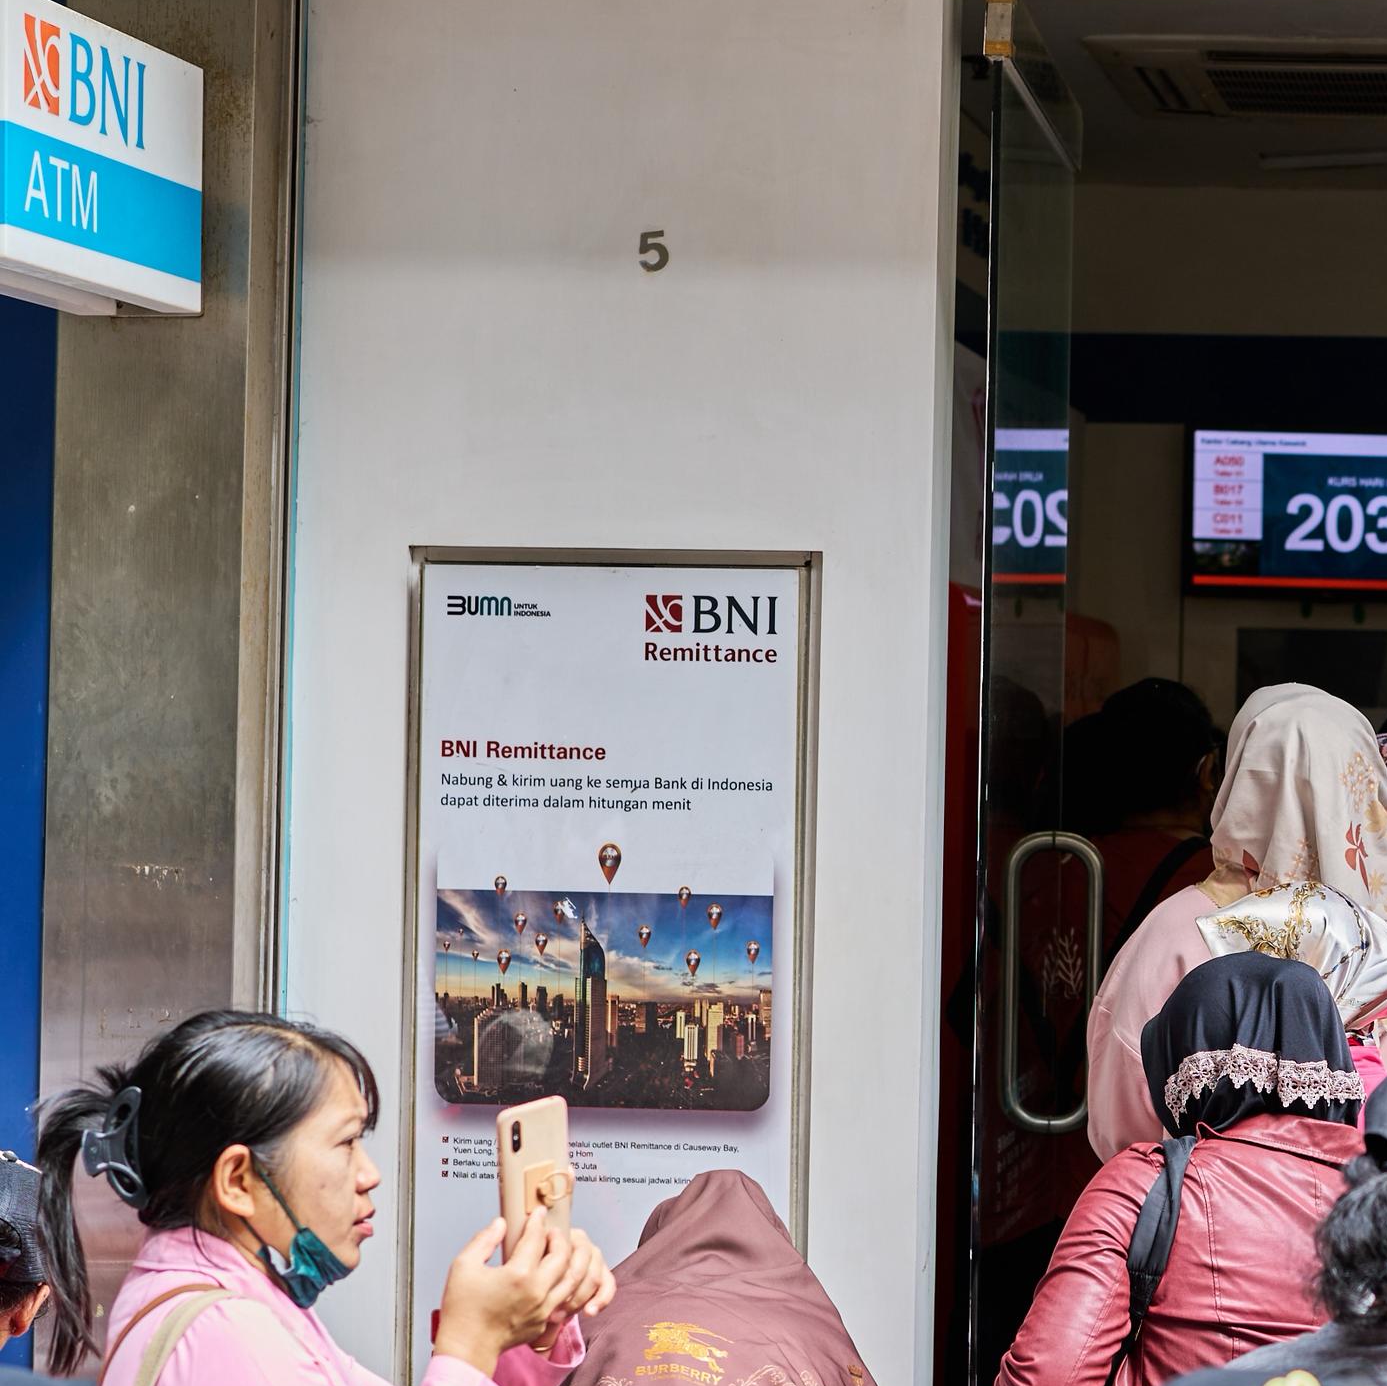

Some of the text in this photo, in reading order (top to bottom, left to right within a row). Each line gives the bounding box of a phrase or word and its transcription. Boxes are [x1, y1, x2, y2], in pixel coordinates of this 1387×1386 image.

[69, 31, 146, 150] BNI
[24, 150, 98, 235] ATM
[639, 229, 669, 273] 5
[693, 595, 778, 636] BNI
[644, 642, 778, 664] Remittance
[441, 740, 606, 761] BNI Remittance
[441, 773, 773, 792] Nabung & kirim uang ke semua Bank di Indonesia
[440, 793, 692, 812] dapat diterima dalam hitungan menit
[453, 1137, 473, 1145] Kirim
[474, 1138, 493, 1147] uang
[592, 1141, 613, 1149] outlet
[614, 1141, 629, 1150] BNI
[630, 1142, 672, 1150] Remittance
[674, 1143, 681, 1151] di
[682, 1143, 722, 1153] Causeway
[723, 1144, 740, 1154] Bay,
[453, 1146, 472, 1154] Yuen
[575, 1150, 594, 1158] Hom
[452, 1158, 481, 1166] Berlaku
[581, 1162, 598, 1170] Juta
[470, 1171, 478, 1179] di
[598, 1175, 621, 1185] kliring
[647, 1176, 672, 1186] jadwal
[673, 1177, 692, 1185] klirin
[634, 1362, 724, 1386] BURBERRY
